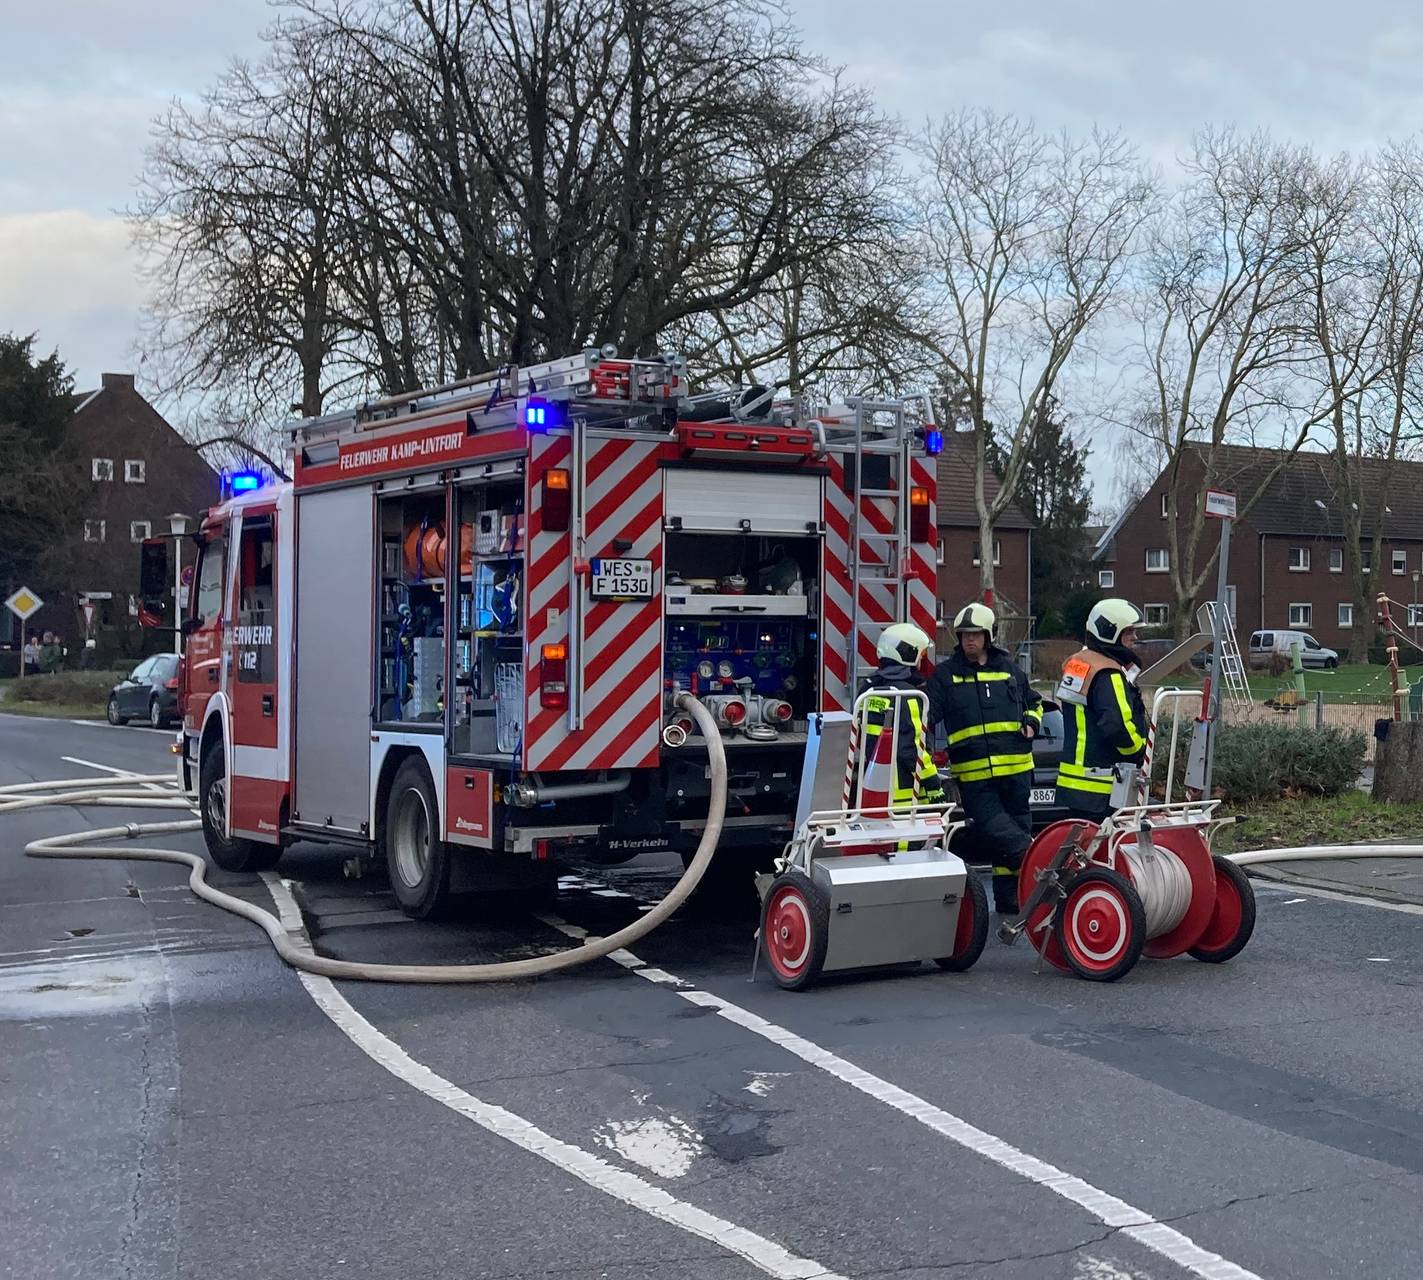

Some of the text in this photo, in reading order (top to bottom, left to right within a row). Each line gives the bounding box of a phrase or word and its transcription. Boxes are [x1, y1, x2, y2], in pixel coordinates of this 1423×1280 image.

[340, 431, 463, 470] FEUERWEHR KAMP-LINTFORT
[603, 561, 633, 577] WES
[597, 578, 648, 593] F 1530
[244, 651, 257, 669] 112
[1033, 790, 1055, 801] 8867
